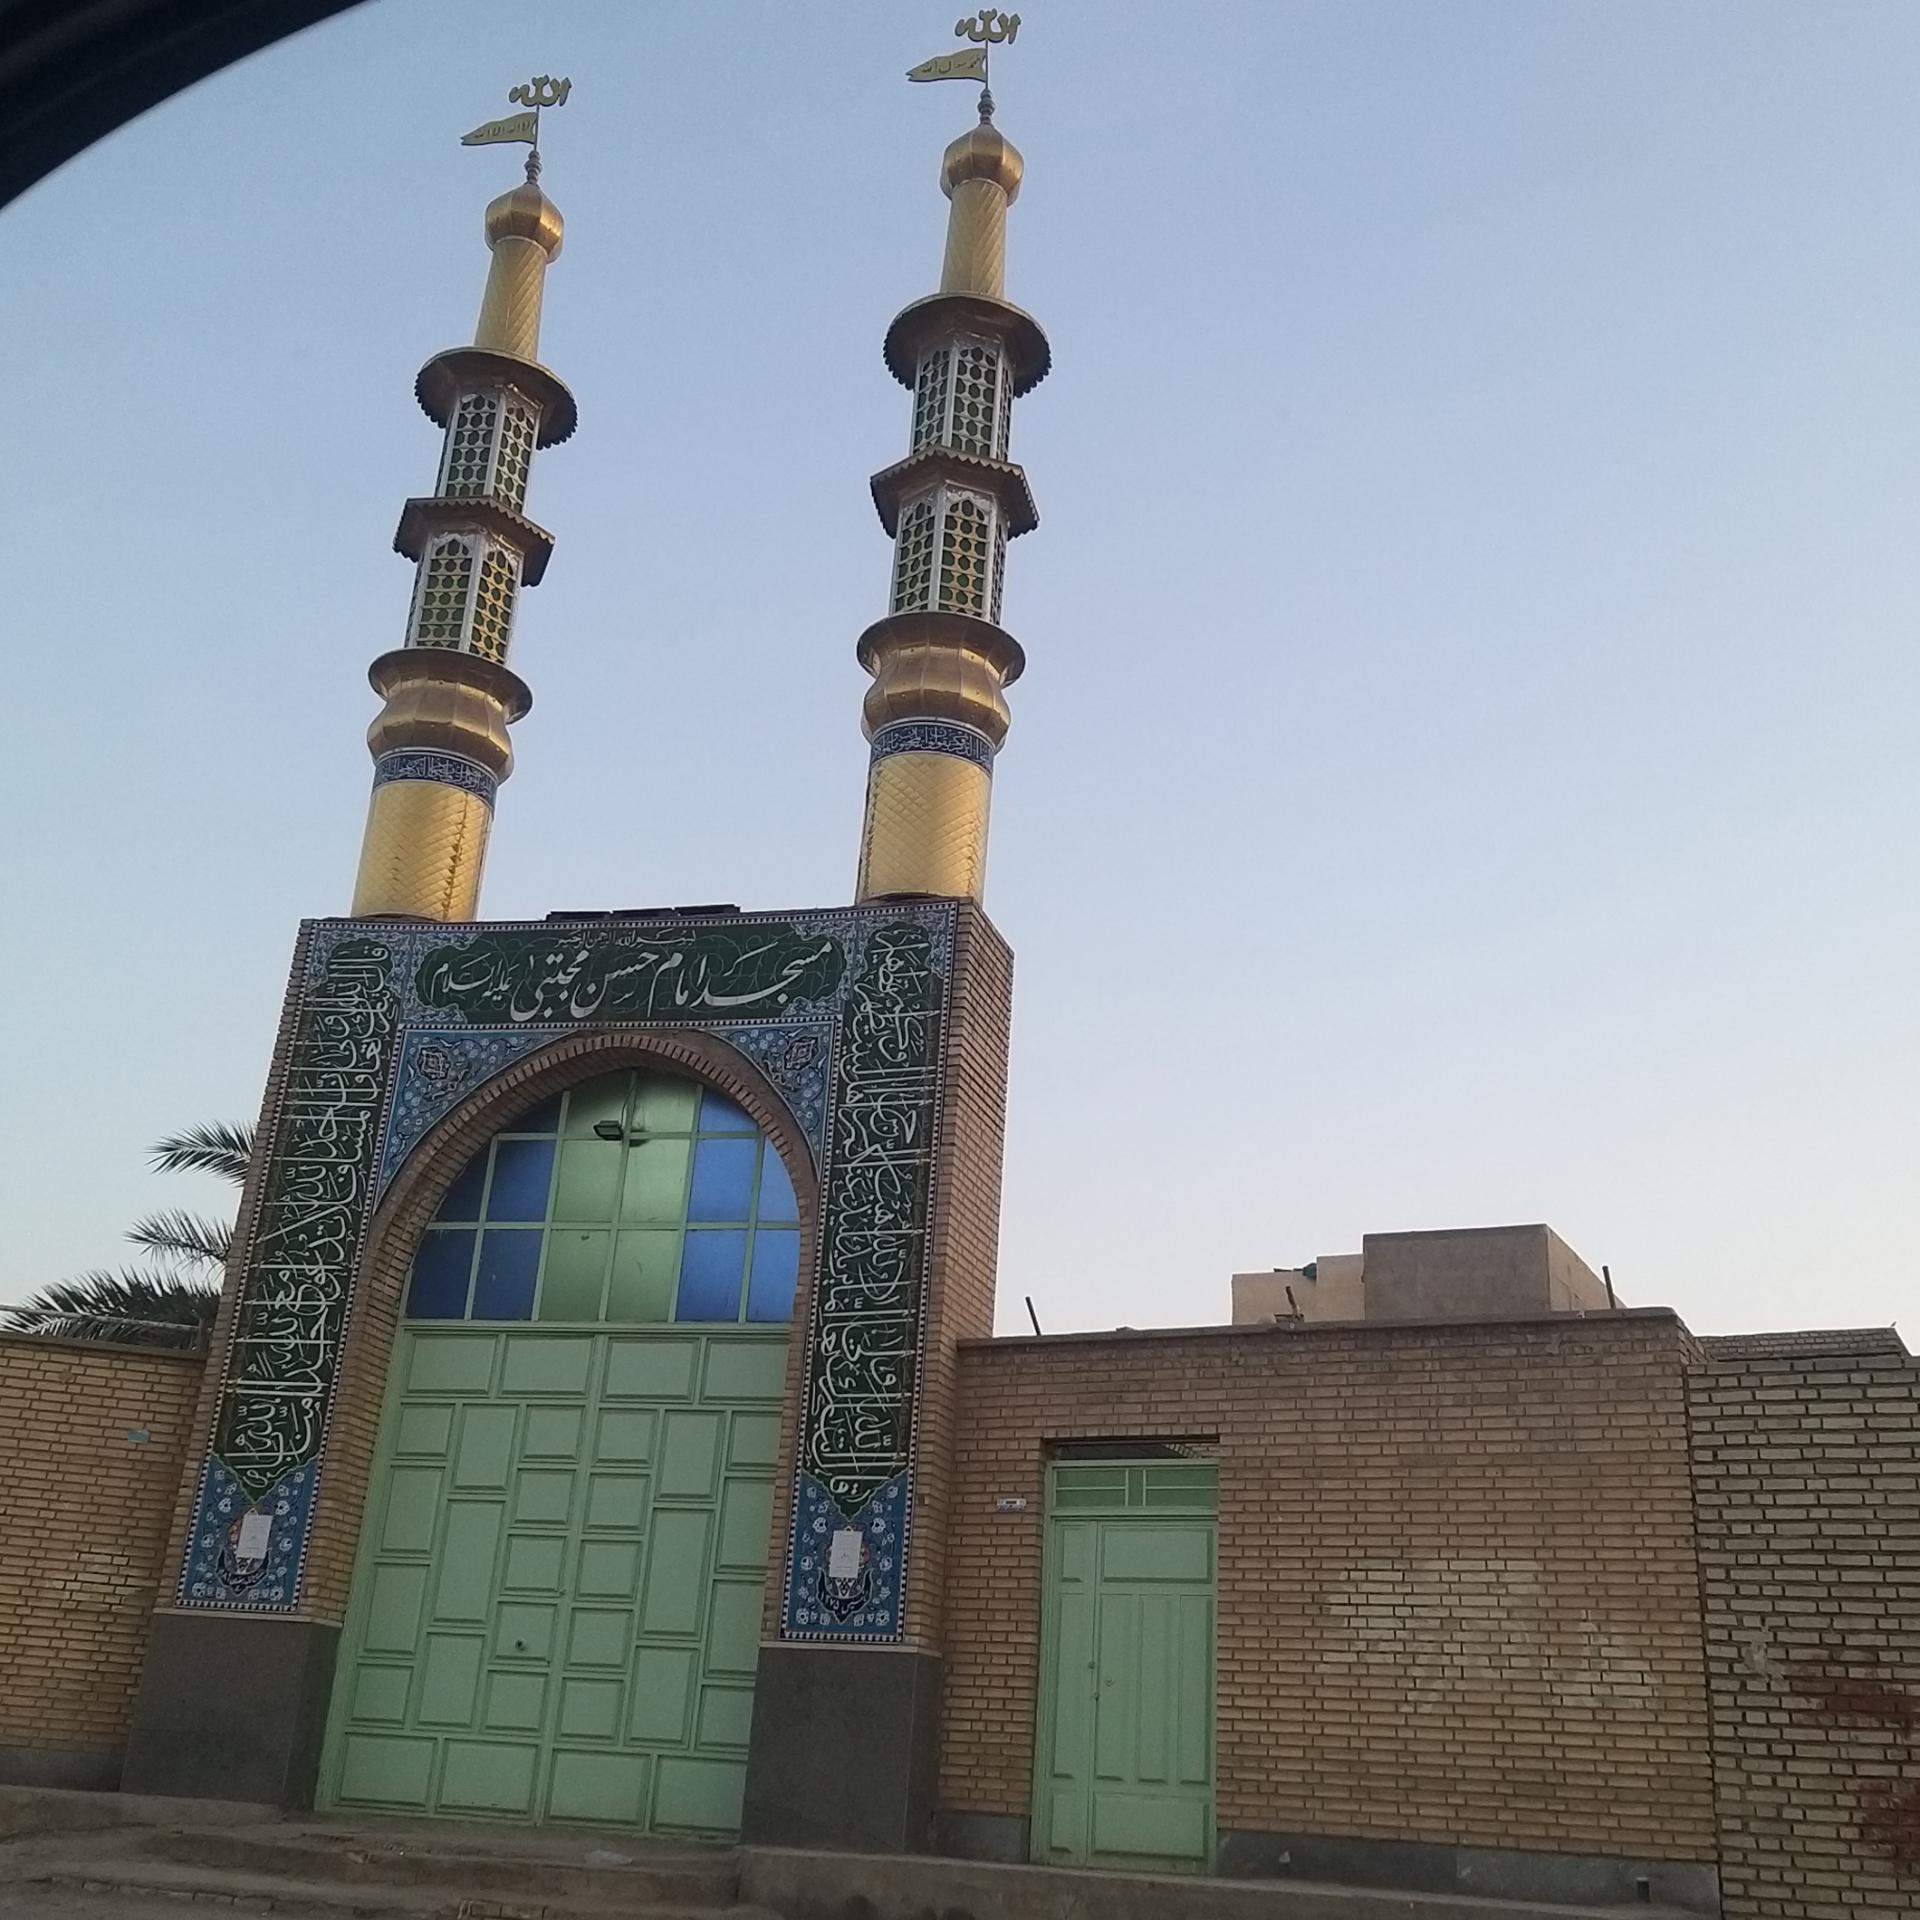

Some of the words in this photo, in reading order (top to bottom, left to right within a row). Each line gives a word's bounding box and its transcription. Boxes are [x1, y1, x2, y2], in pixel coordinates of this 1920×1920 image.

[954, 8, 1021, 45] الله
[508, 74, 572, 107] الله
[614, 930, 637, 948] الله
[633, 927, 697, 948] بسم
[430, 952, 503, 1002] السلام
[570, 950, 660, 1017] حسن
[646, 949, 707, 1015] امام
[702, 940, 833, 1006] مسجد
